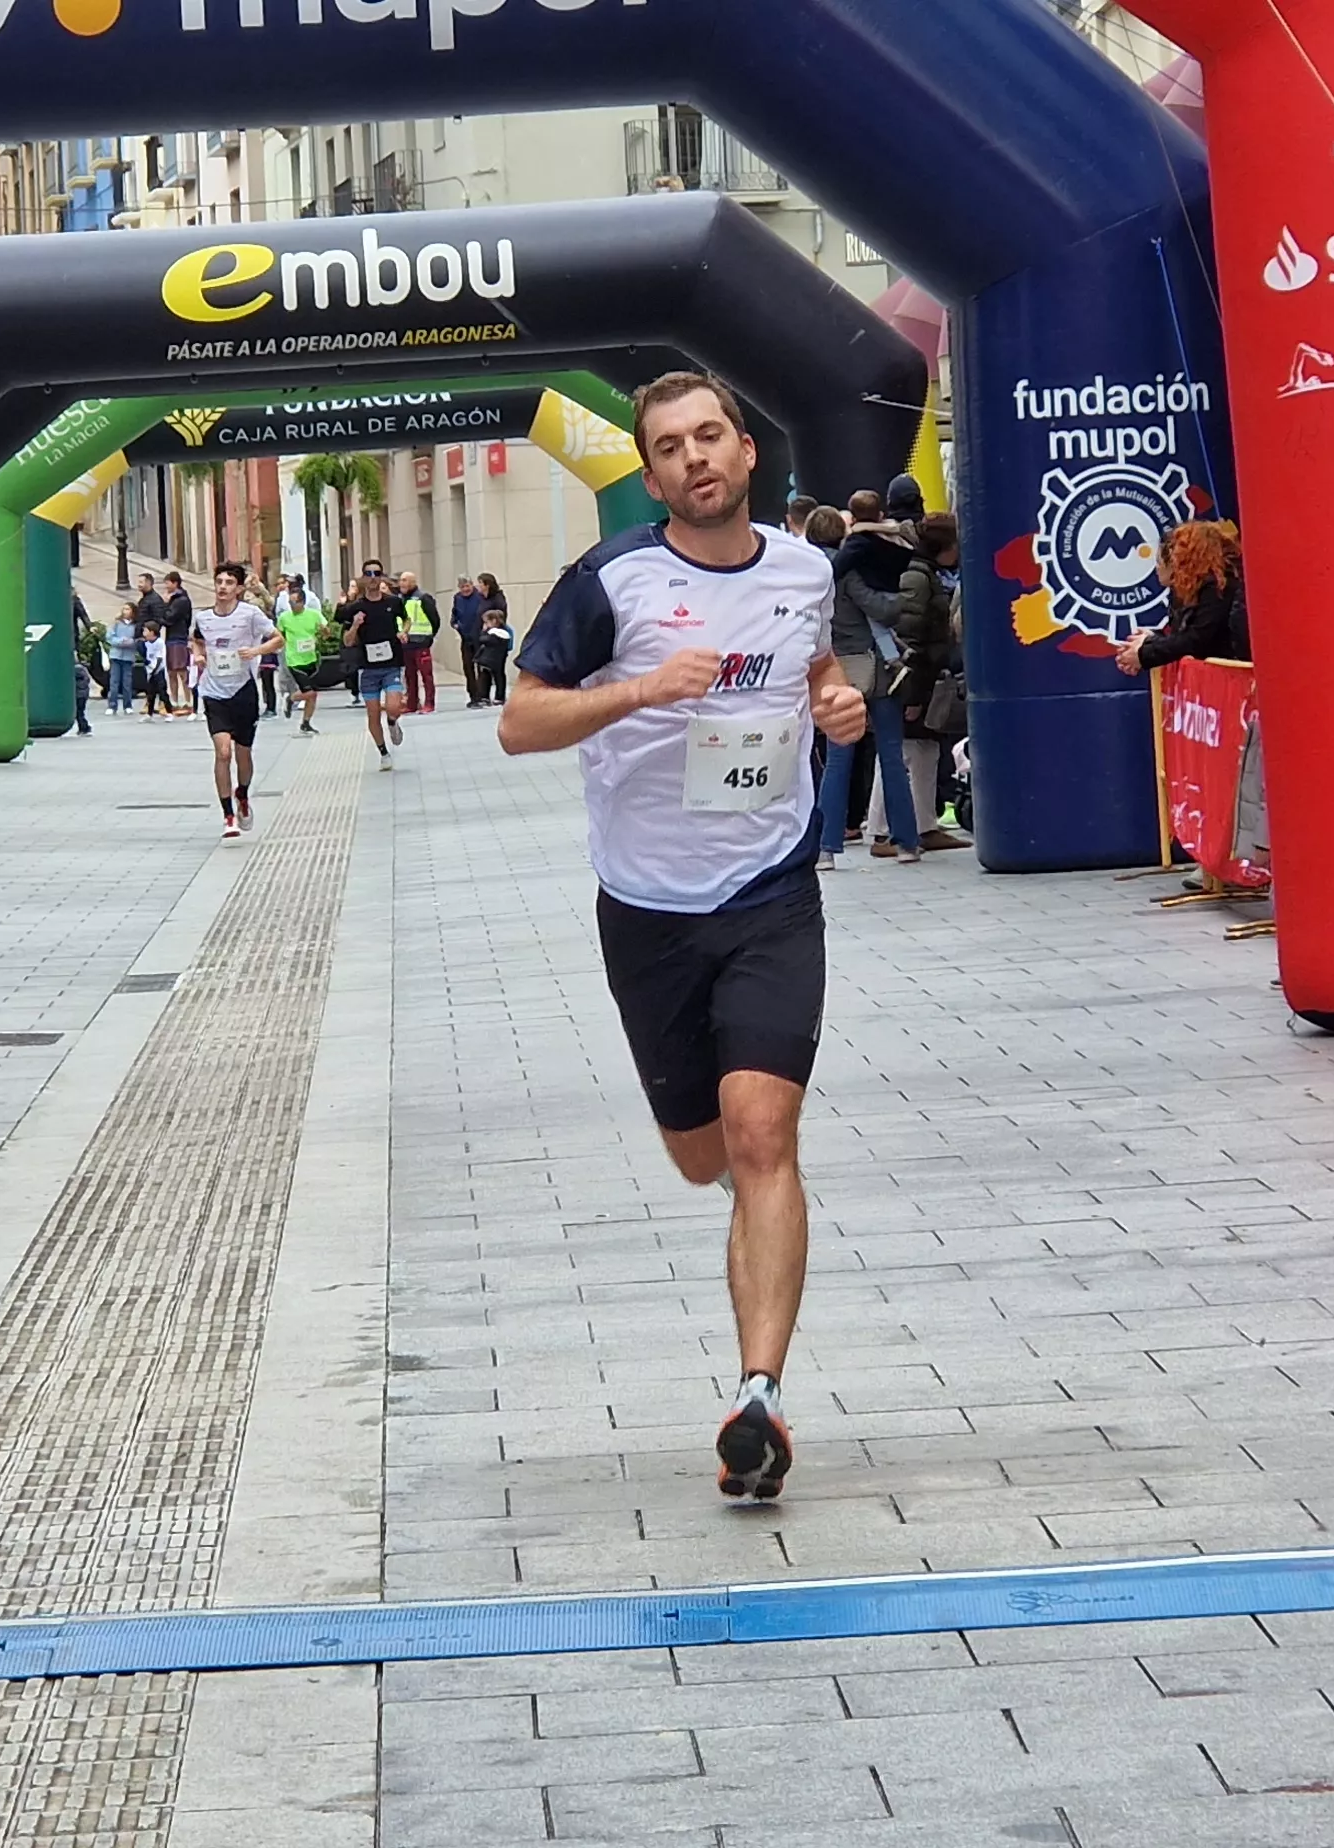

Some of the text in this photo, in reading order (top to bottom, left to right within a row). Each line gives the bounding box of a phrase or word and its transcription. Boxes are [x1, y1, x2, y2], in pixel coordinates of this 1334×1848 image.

[162, 228, 515, 322] embou
[166, 323, 517, 361] PÁSATE A LA OPERADORA ARAGONESA
[1012, 371, 1211, 420] fundación
[218, 408, 502, 445] CAJA RURAL DE ARAGÓN
[1048, 415, 1176, 465] mupol
[1090, 586, 1153, 606] POLICÍA
[723, 765, 769, 789] 456
